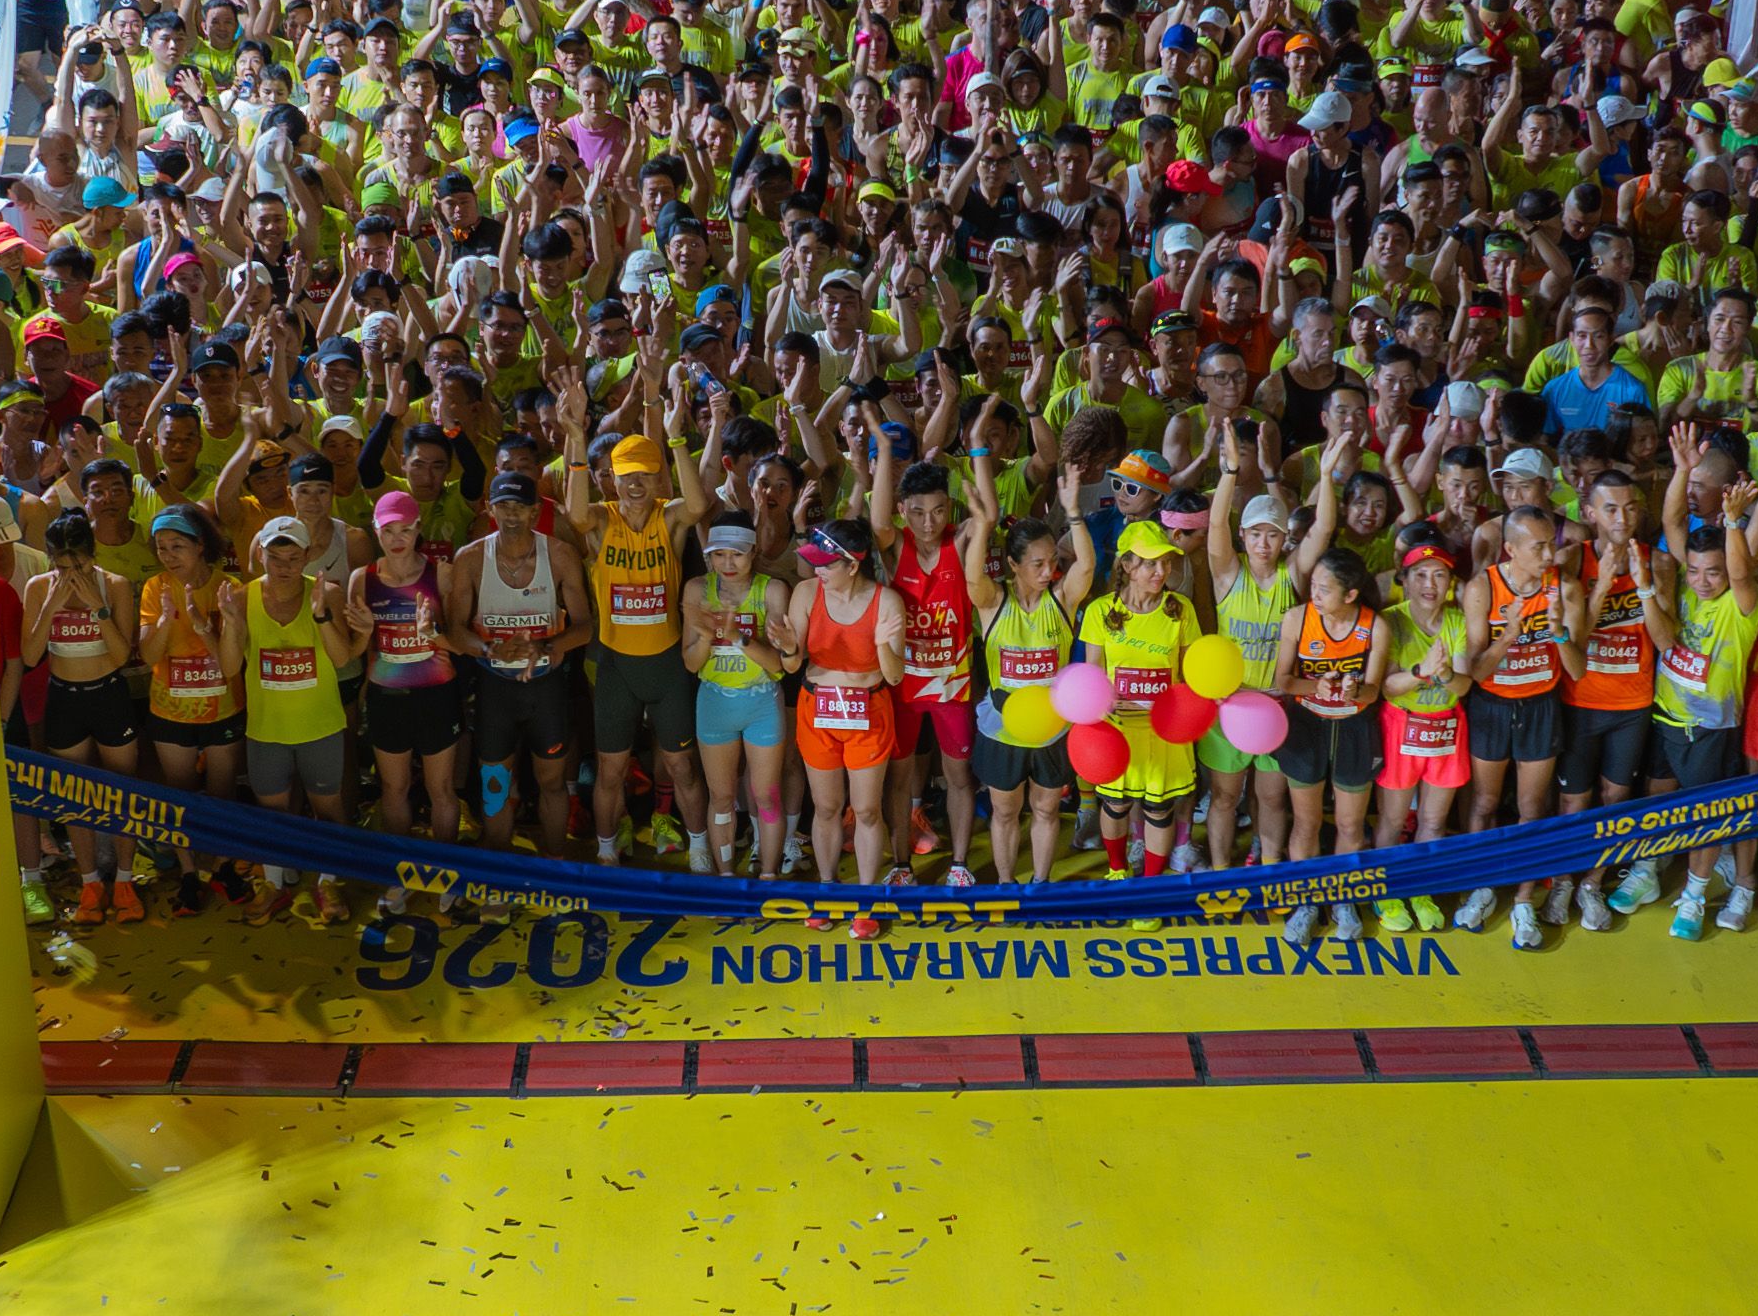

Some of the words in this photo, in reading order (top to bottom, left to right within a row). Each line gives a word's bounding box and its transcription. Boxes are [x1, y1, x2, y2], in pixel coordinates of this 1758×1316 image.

[605, 545, 666, 571] BAYLOR
[625, 597, 664, 610] 80474
[483, 613, 551, 627] GARMIN
[61, 624, 100, 636] 80479
[392, 635, 429, 649] 80212
[915, 650, 952, 662] 81449
[1599, 645, 1639, 659] 80442
[275, 662, 314, 675] 82395
[1016, 661, 1055, 674] 83923
[1509, 655, 1550, 670] 80453
[184, 669, 223, 682] 83454
[1129, 681, 1169, 695] 81860
[49, 769, 123, 815] MINH
[128, 790, 187, 828] CITY
[465, 881, 590, 912] Marathon
[1262, 881, 1388, 908] Marathon
[355, 912, 691, 991] 2026
[1090, 935, 1461, 980] VNEXPRESS
[712, 937, 1072, 986] MARATHON
